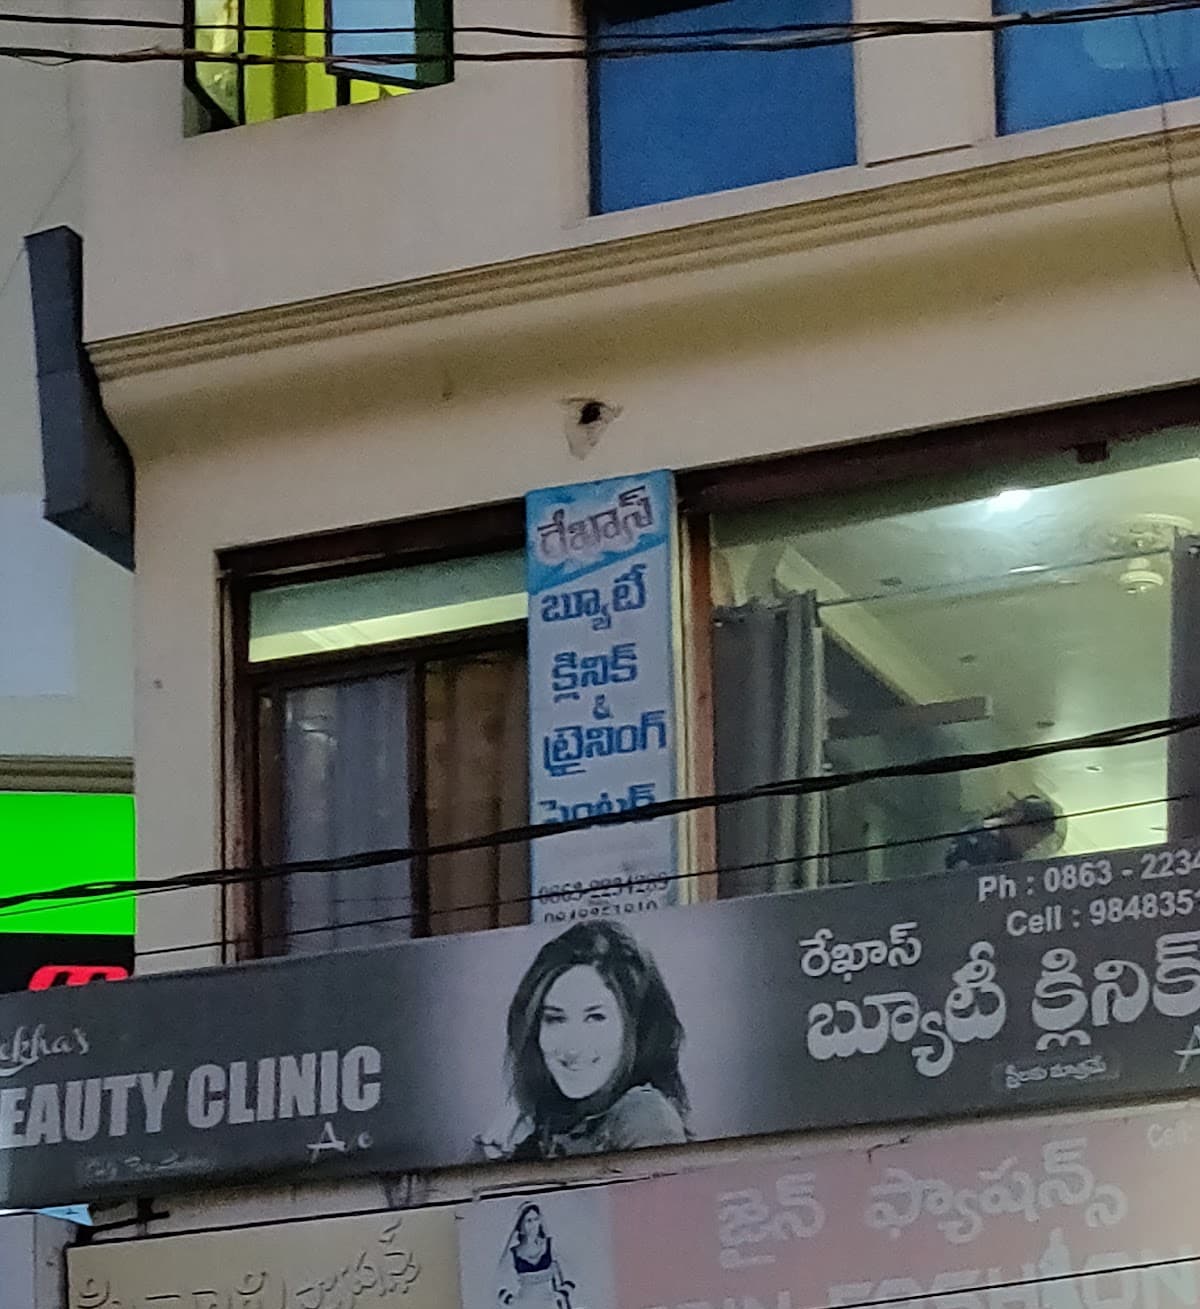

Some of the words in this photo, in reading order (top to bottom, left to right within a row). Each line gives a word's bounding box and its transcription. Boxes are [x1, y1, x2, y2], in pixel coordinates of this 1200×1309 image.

[978, 874, 1017, 902] Ph
[1043, 859, 1113, 893] 0863
[1005, 904, 1063, 937] Cell
[1089, 889, 1200, 927] 984835
[799, 921, 923, 982] రేఖాస్
[807, 940, 1007, 1078] బ్యూటీ
[187, 1045, 382, 1130] CLINIC
